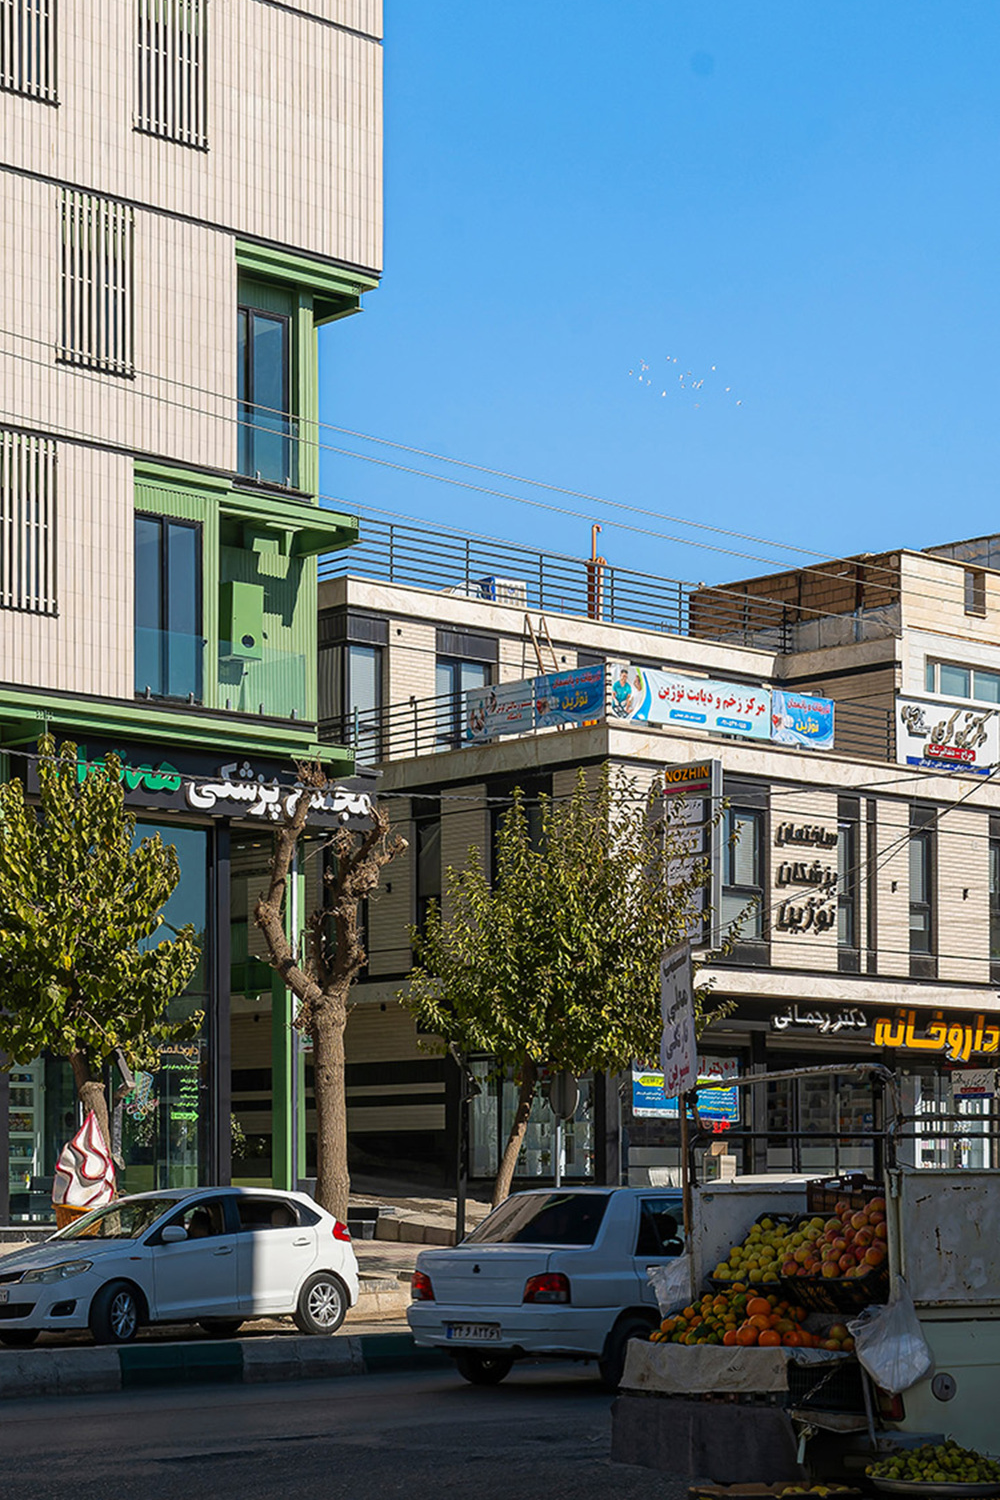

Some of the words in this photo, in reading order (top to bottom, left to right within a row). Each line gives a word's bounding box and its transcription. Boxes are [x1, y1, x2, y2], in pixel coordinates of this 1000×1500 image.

[686, 688, 713, 707] دیابت
[715, 697, 721, 710] و
[723, 693, 742, 712] زخم
[745, 698, 766, 716] مرکز
[665, 766, 709, 783] NOZHIN
[187, 761, 282, 820] پزشکی
[775, 822, 839, 848] ساختمان
[775, 860, 839, 898] پزشکان
[774, 1003, 831, 1033] رحمانی
[832, 1007, 868, 1033] دکتر
[873, 1008, 1000, 1062] داروخانه
